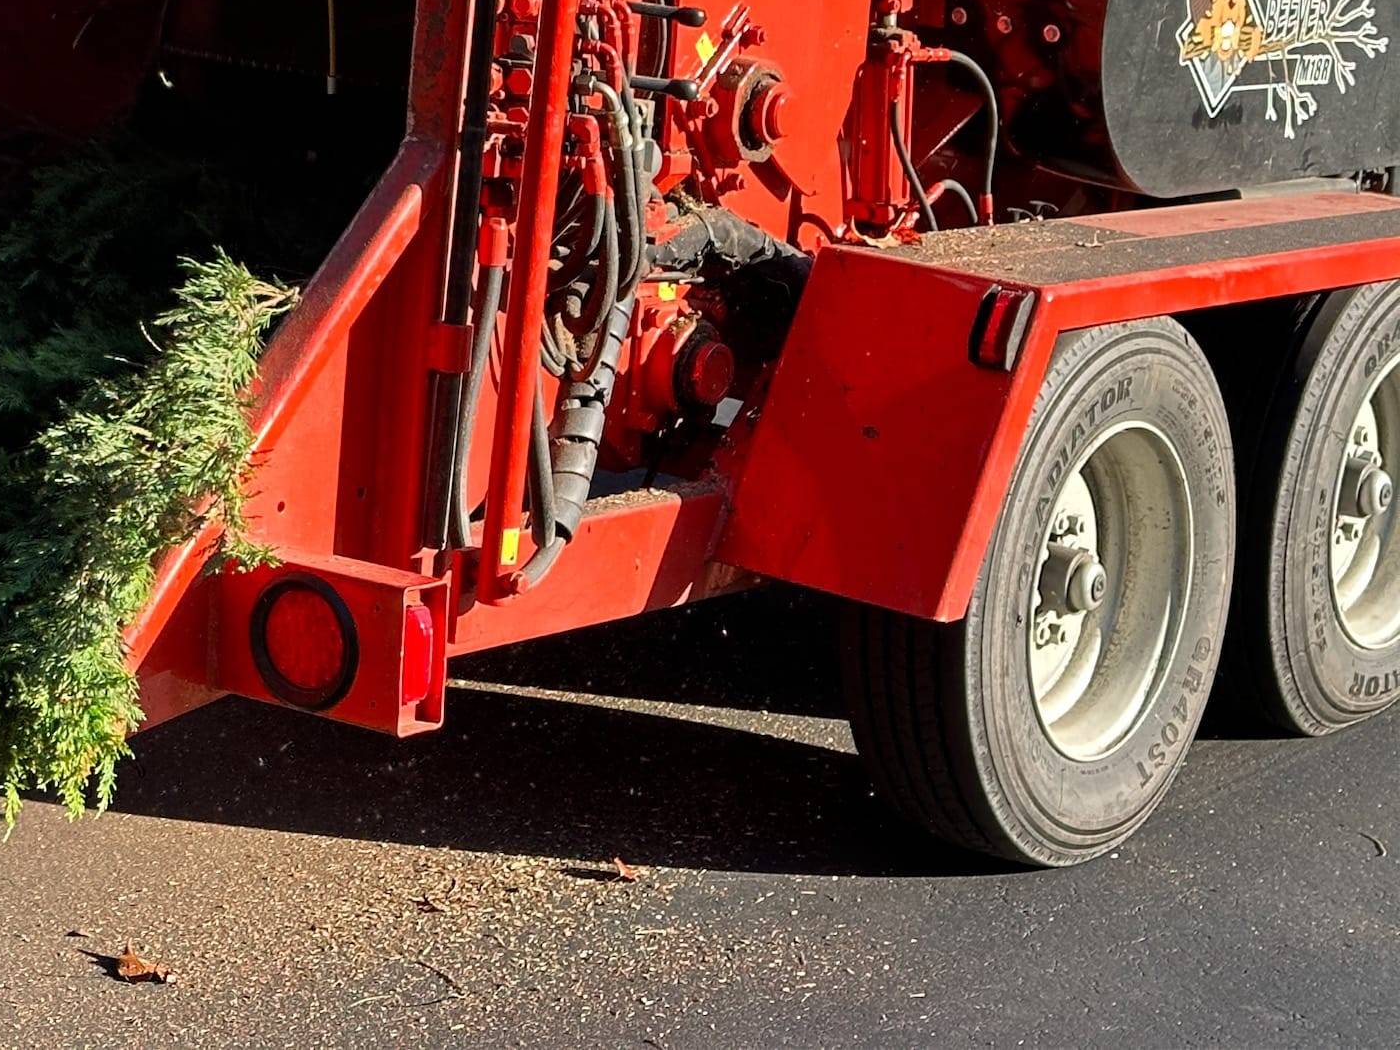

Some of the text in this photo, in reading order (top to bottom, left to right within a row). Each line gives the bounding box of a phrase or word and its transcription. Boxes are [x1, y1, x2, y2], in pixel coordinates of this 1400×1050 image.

[1298, 56, 1331, 83] M18R
[1017, 376, 1134, 592] GLADIATOR
[1136, 635, 1213, 790] QR40ST
